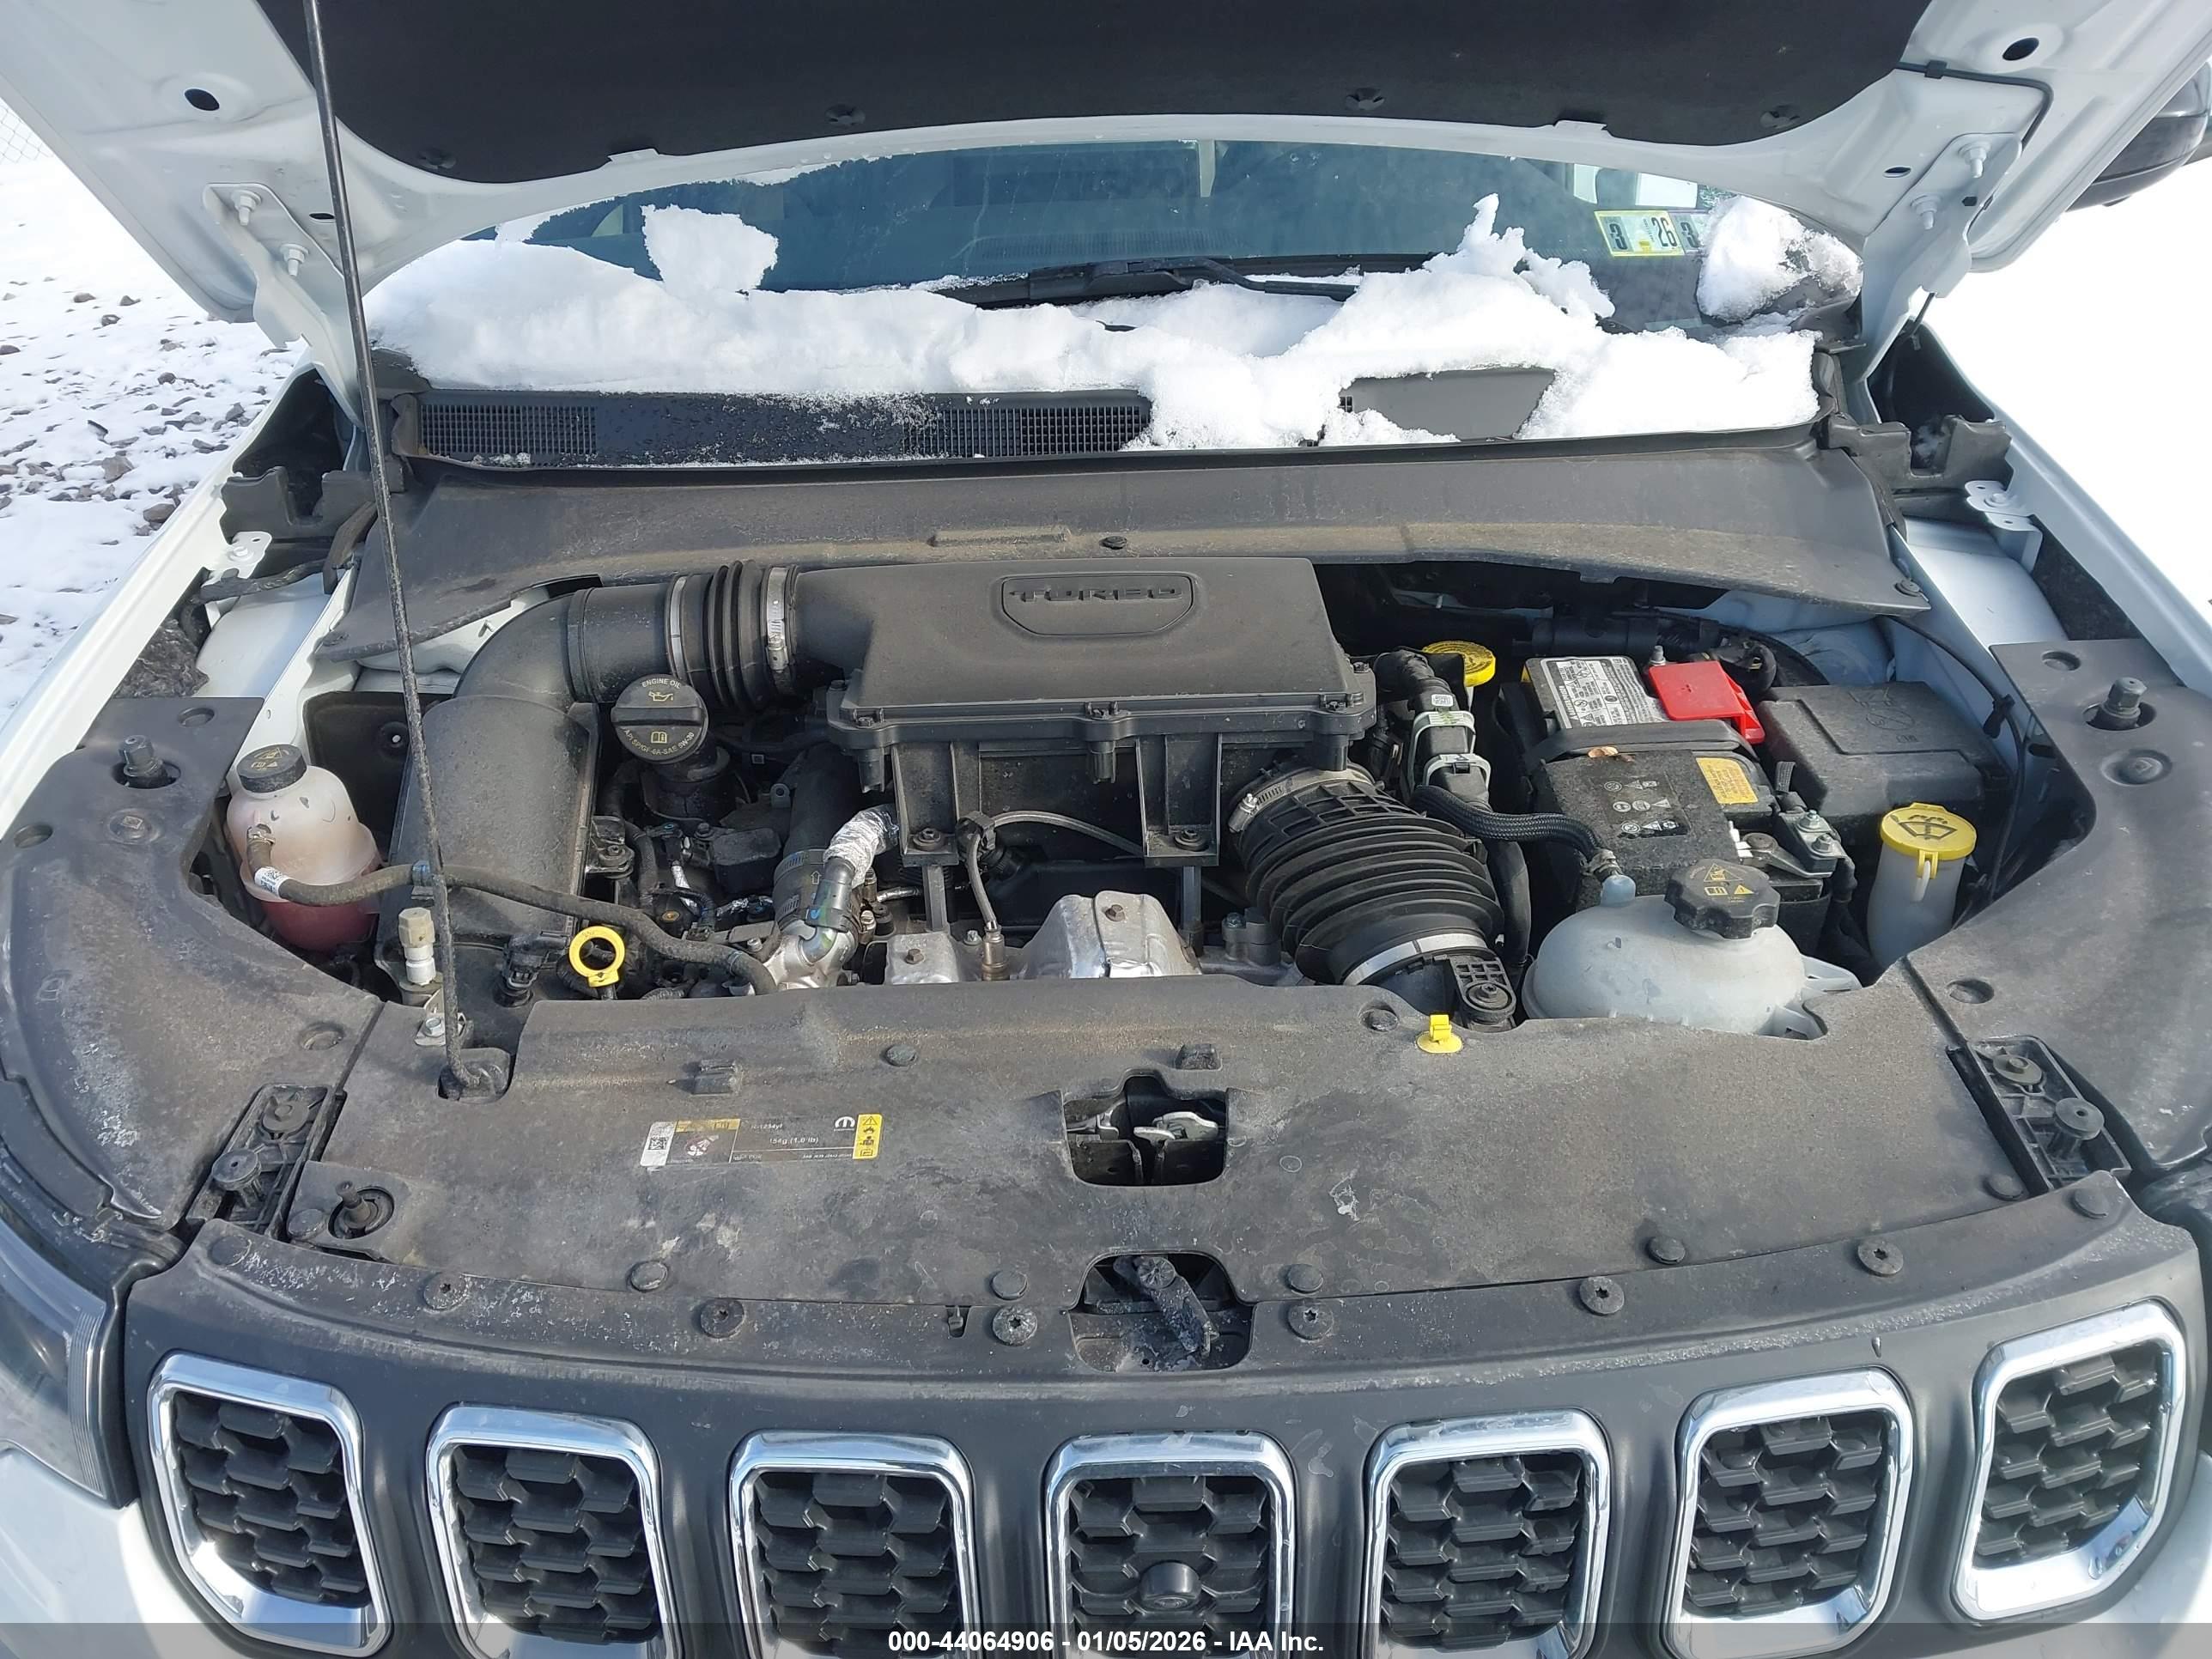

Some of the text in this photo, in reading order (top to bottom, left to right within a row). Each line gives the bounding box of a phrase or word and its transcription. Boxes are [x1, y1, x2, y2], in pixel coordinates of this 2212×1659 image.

[1609, 223, 1628, 250] 3
[1651, 217, 1678, 247] 26
[641, 678, 681, 689] ENGINE OIL
